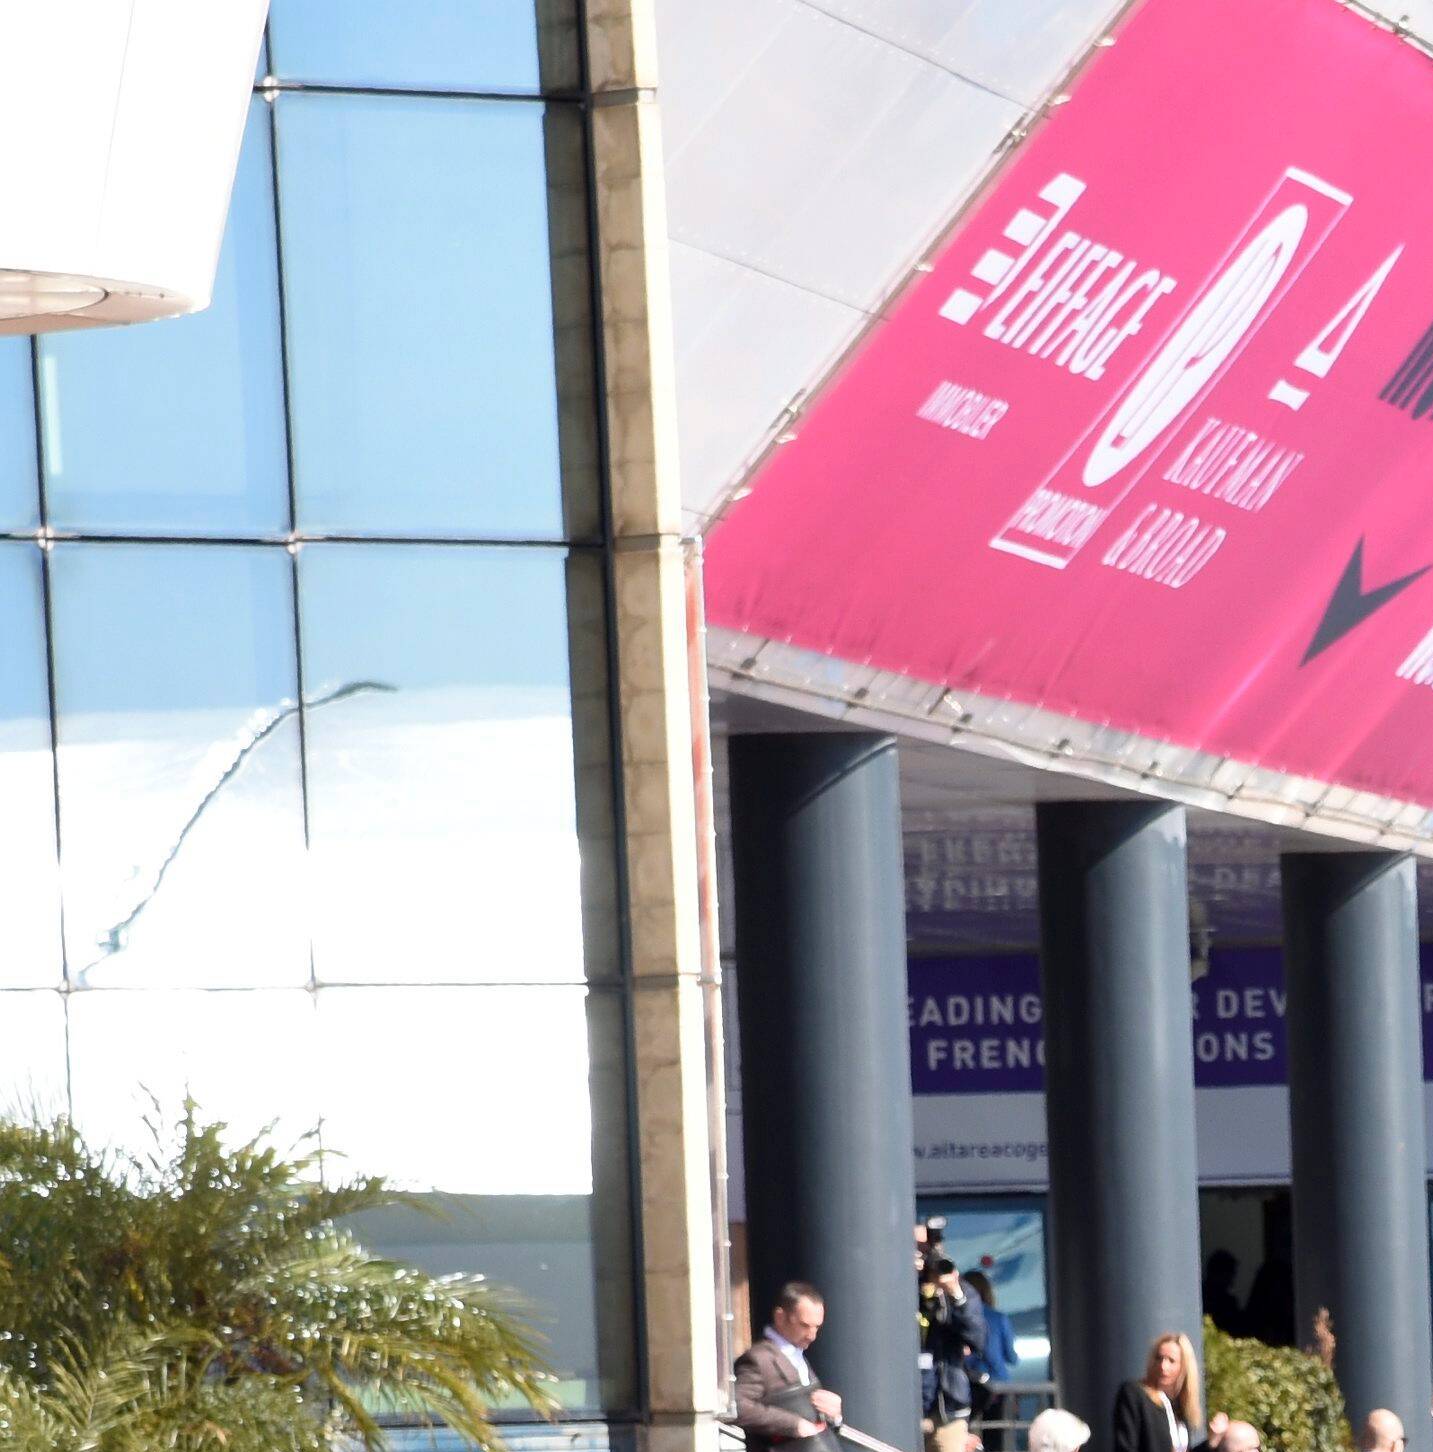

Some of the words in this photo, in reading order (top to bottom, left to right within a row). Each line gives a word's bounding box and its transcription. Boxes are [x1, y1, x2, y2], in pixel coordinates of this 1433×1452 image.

[981, 231, 1178, 383] EIFFAGE
[916, 380, 1010, 442] IMMOBILIER
[1162, 417, 1305, 515] KAUFMAN
[1007, 488, 1110, 547] PROMOTION
[1216, 985, 1287, 1020] DEV
[1195, 1031, 1276, 1063] ONS
